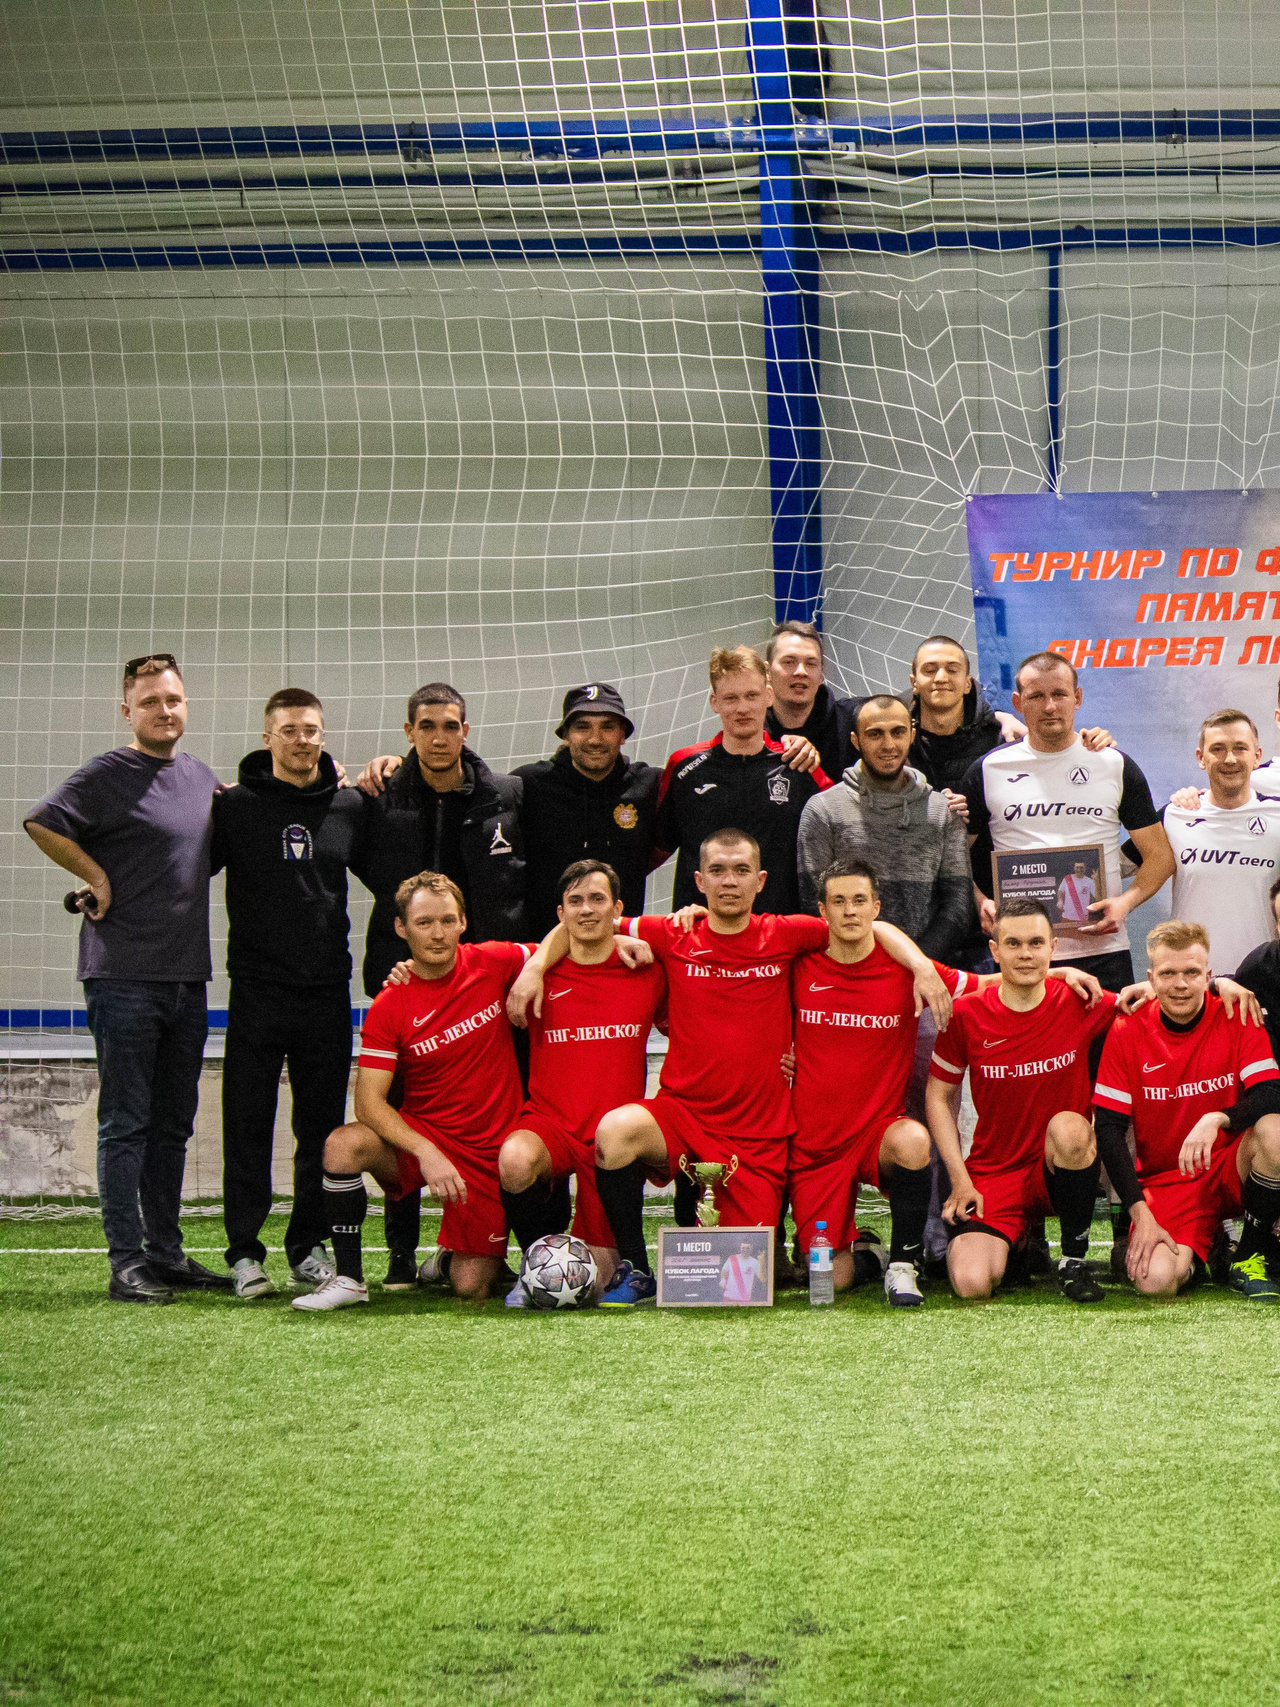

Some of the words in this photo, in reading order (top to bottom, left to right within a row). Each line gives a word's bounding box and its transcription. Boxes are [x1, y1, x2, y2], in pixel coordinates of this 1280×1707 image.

[988, 549, 1165, 582] ТУРНИР
[1176, 547, 1242, 578] ПО
[1026, 803, 1066, 817] UVT
[1066, 807, 1103, 816] aero
[1200, 849, 1240, 865] UVT
[1239, 857, 1275, 868] aero
[1012, 865, 1018, 875] 2
[1019, 863, 1047, 875] МЕСТО
[800, 1009, 900, 1029] ТНГ-ЛЕНСКОЕ
[676, 1242, 681, 1252] 1
[683, 1242, 711, 1252] МЕСТО
